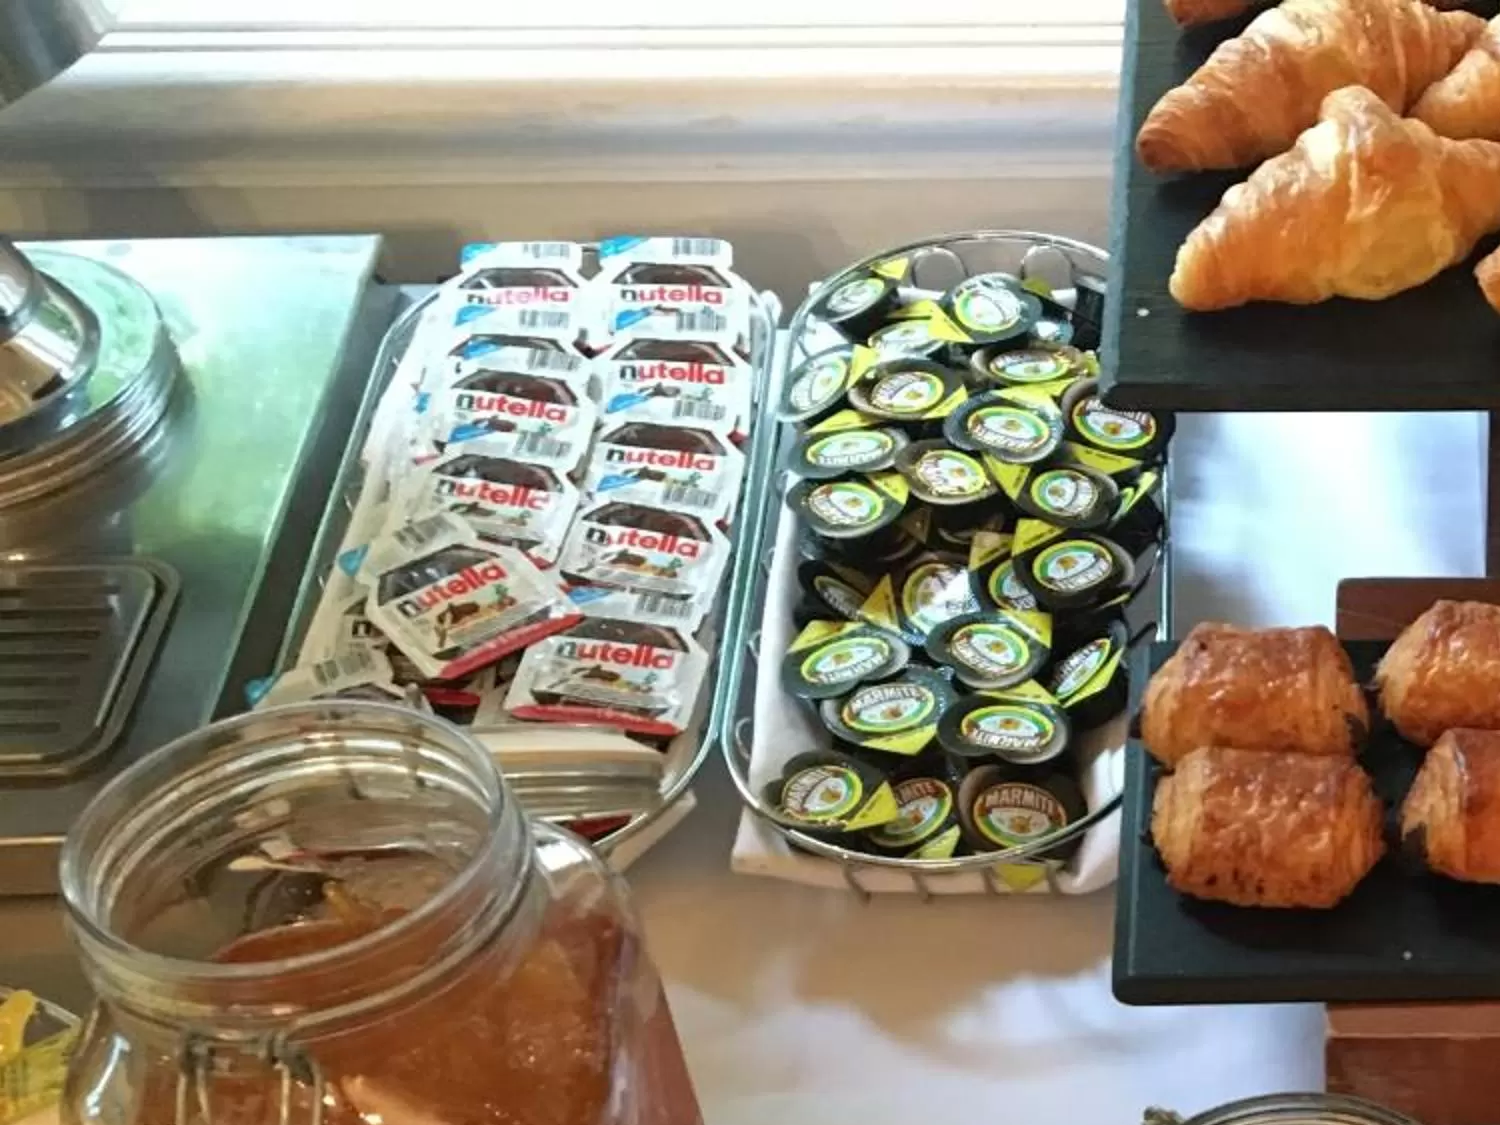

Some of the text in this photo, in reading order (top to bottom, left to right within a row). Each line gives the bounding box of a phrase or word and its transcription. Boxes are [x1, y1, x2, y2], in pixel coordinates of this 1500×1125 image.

[467, 286, 570, 305] nutella
[620, 282, 723, 305] nutella
[619, 359, 725, 386] nutella
[456, 393, 567, 423] nutella
[606, 448, 716, 471] nutella
[397, 561, 508, 618] nutella
[556, 640, 675, 669] nutella
[983, 786, 1055, 816] MARMITE
